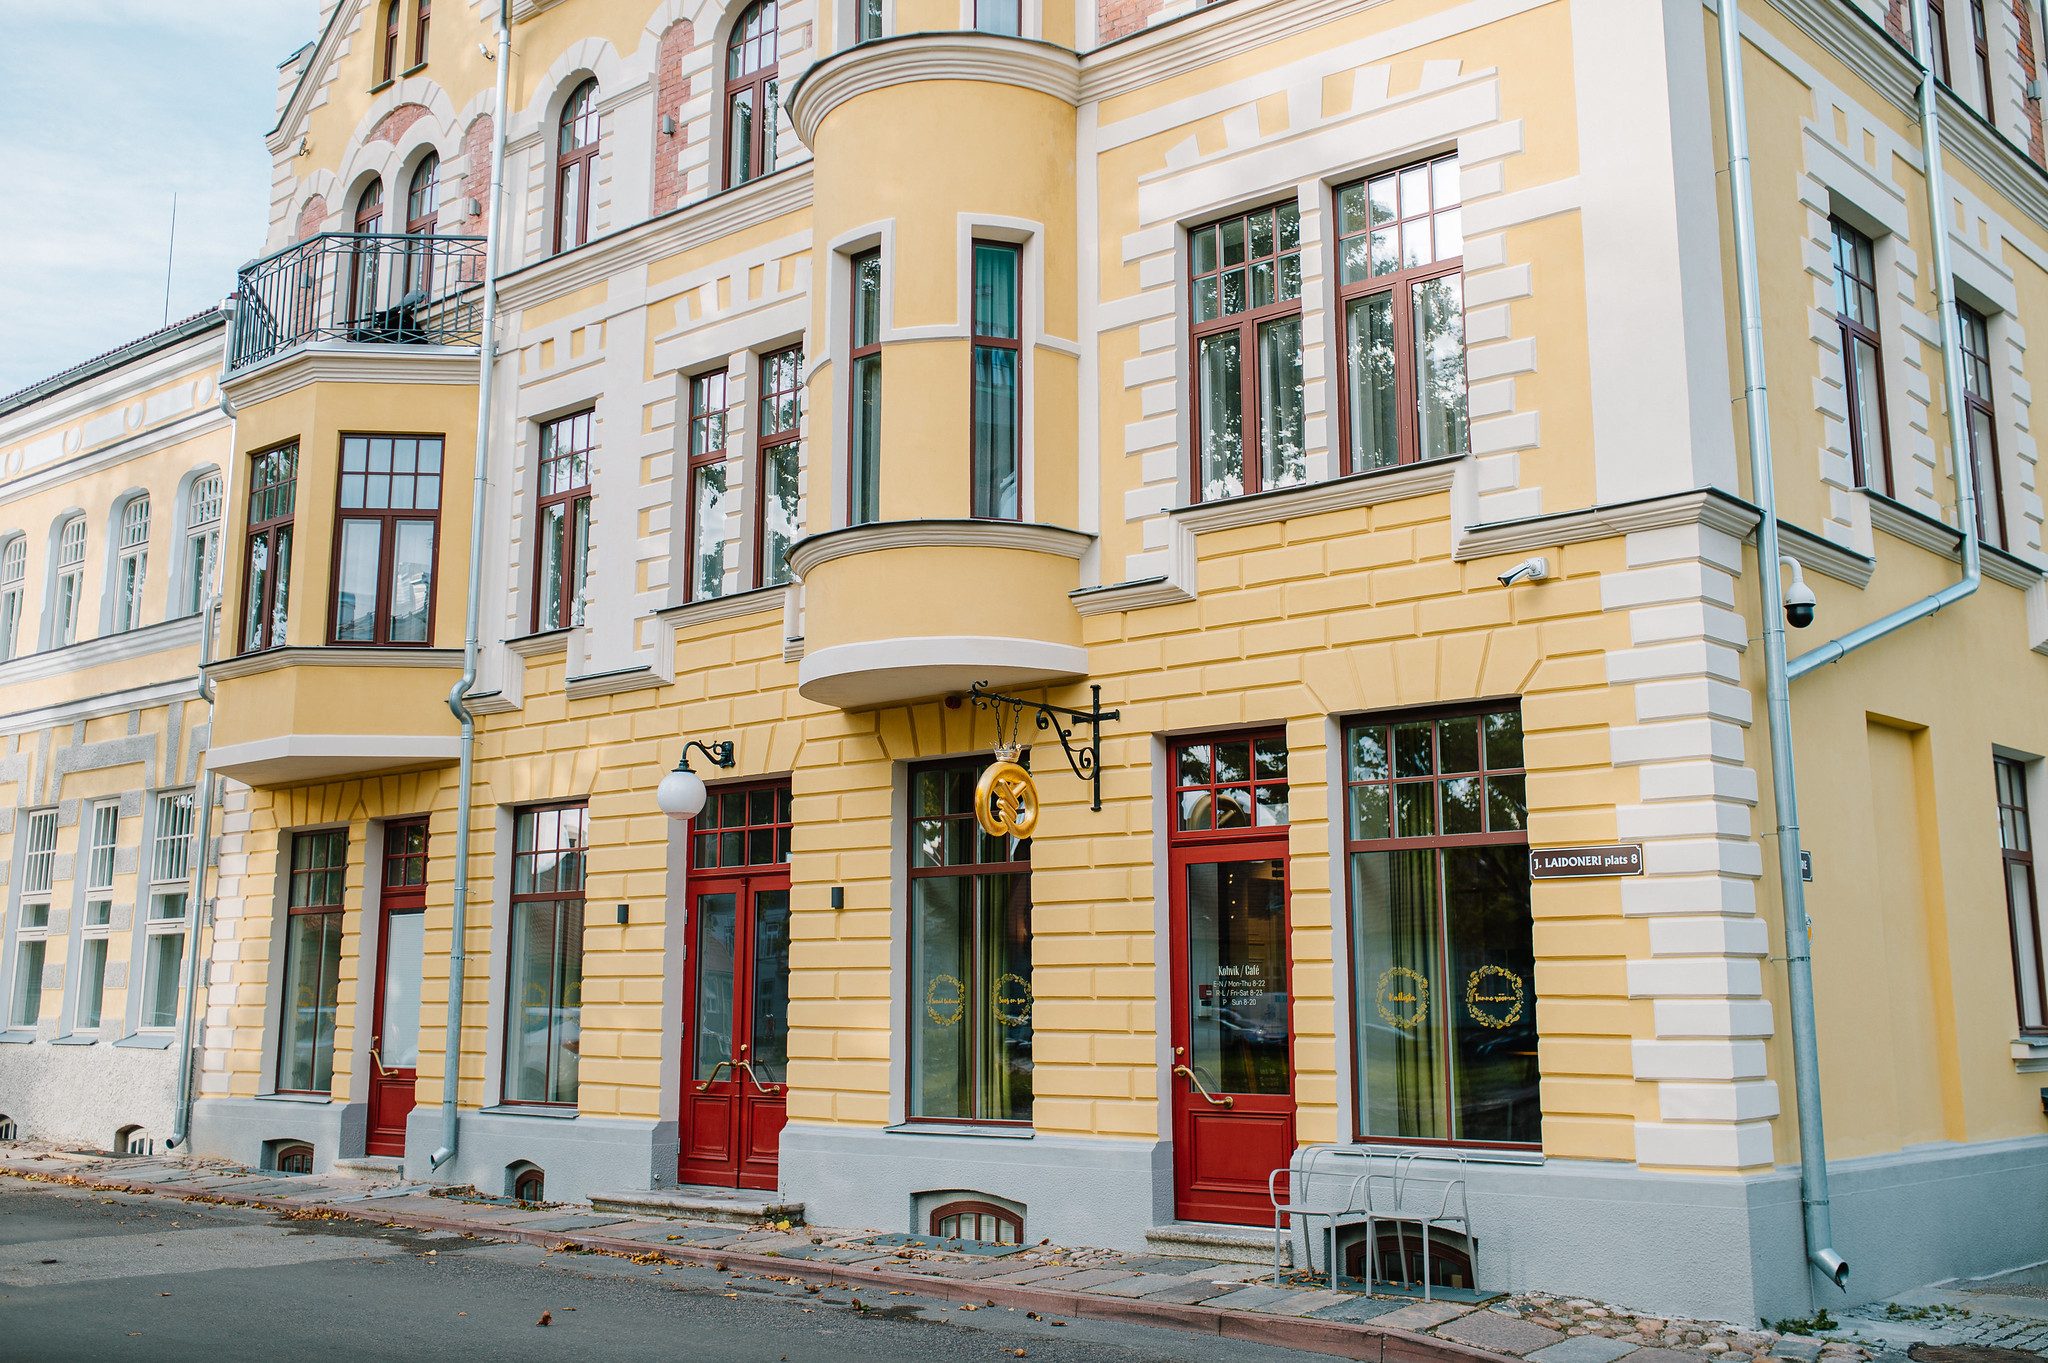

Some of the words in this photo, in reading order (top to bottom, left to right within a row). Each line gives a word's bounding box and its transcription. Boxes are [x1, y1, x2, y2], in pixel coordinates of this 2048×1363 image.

[1533, 858, 1542, 870] J.
[1544, 855, 1602, 868] LAIDONERI
[1604, 855, 1628, 867] plats
[1630, 853, 1638, 864] 8
[1218, 965, 1240, 976] Kohvik
[1245, 964, 1260, 976] Café
[1252, 979, 1266, 987] 8-22
[1231, 998, 1243, 1006] Sun
[1243, 998, 1257, 1006] 8-20
